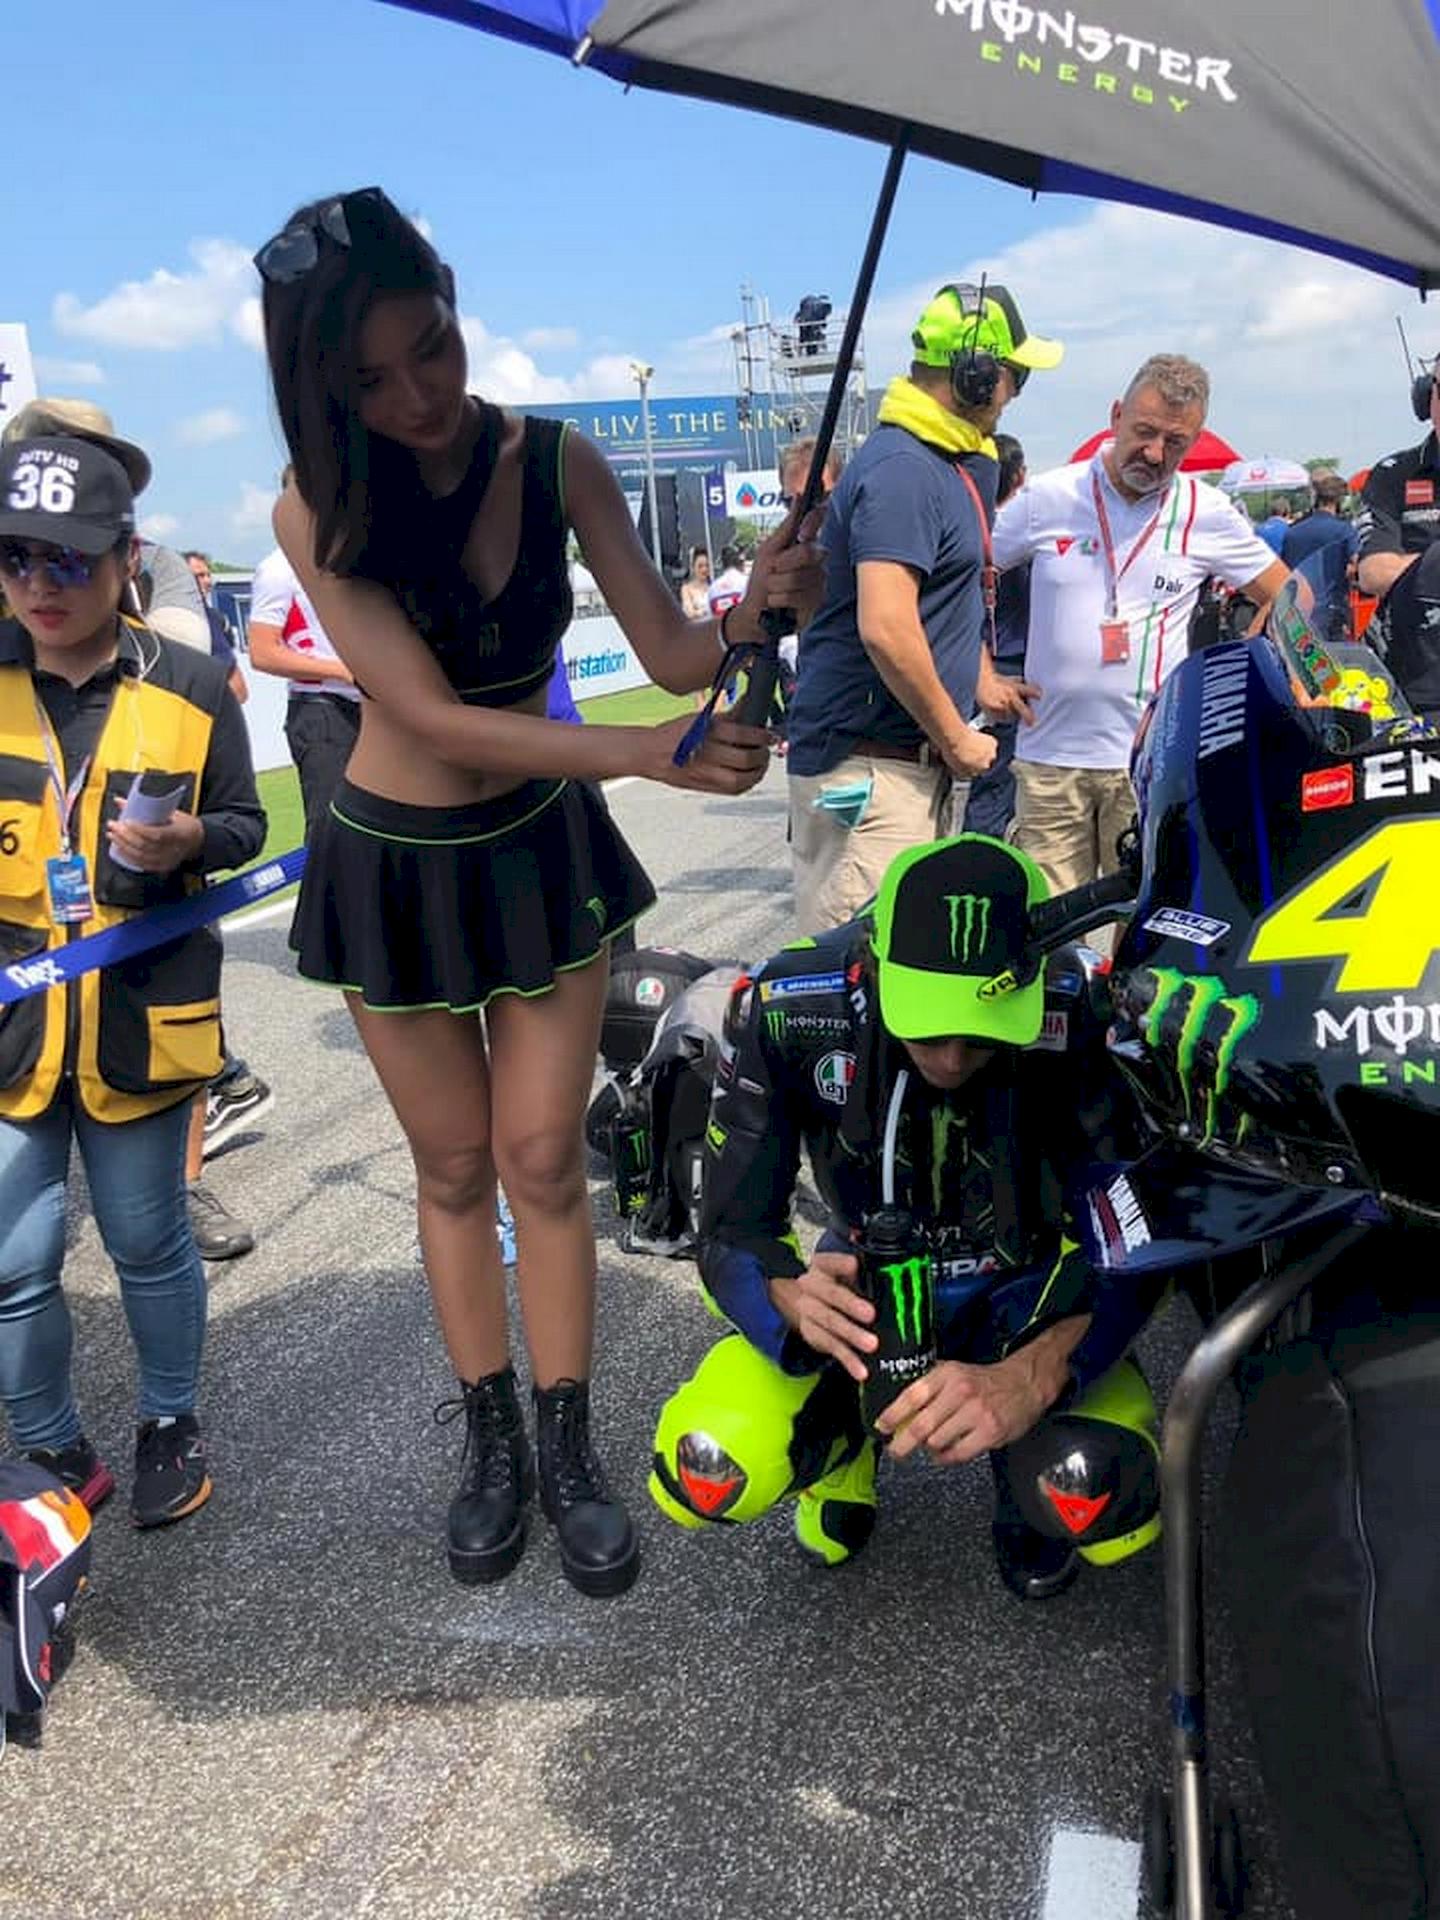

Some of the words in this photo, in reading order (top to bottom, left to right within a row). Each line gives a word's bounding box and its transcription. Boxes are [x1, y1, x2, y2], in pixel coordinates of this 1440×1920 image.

[980, 41, 1190, 112] ENERGY
[593, 414, 658, 437] LIVE
[668, 410, 727, 434] THE
[8, 463, 76, 513] 36
[708, 487, 724, 506] 5
[579, 647, 626, 677] station
[1197, 646, 1250, 760] YAMAHA
[1248, 817, 1440, 993] 4
[785, 1015, 852, 1031] MONSTER
[1359, 1060, 1435, 1085] EN
